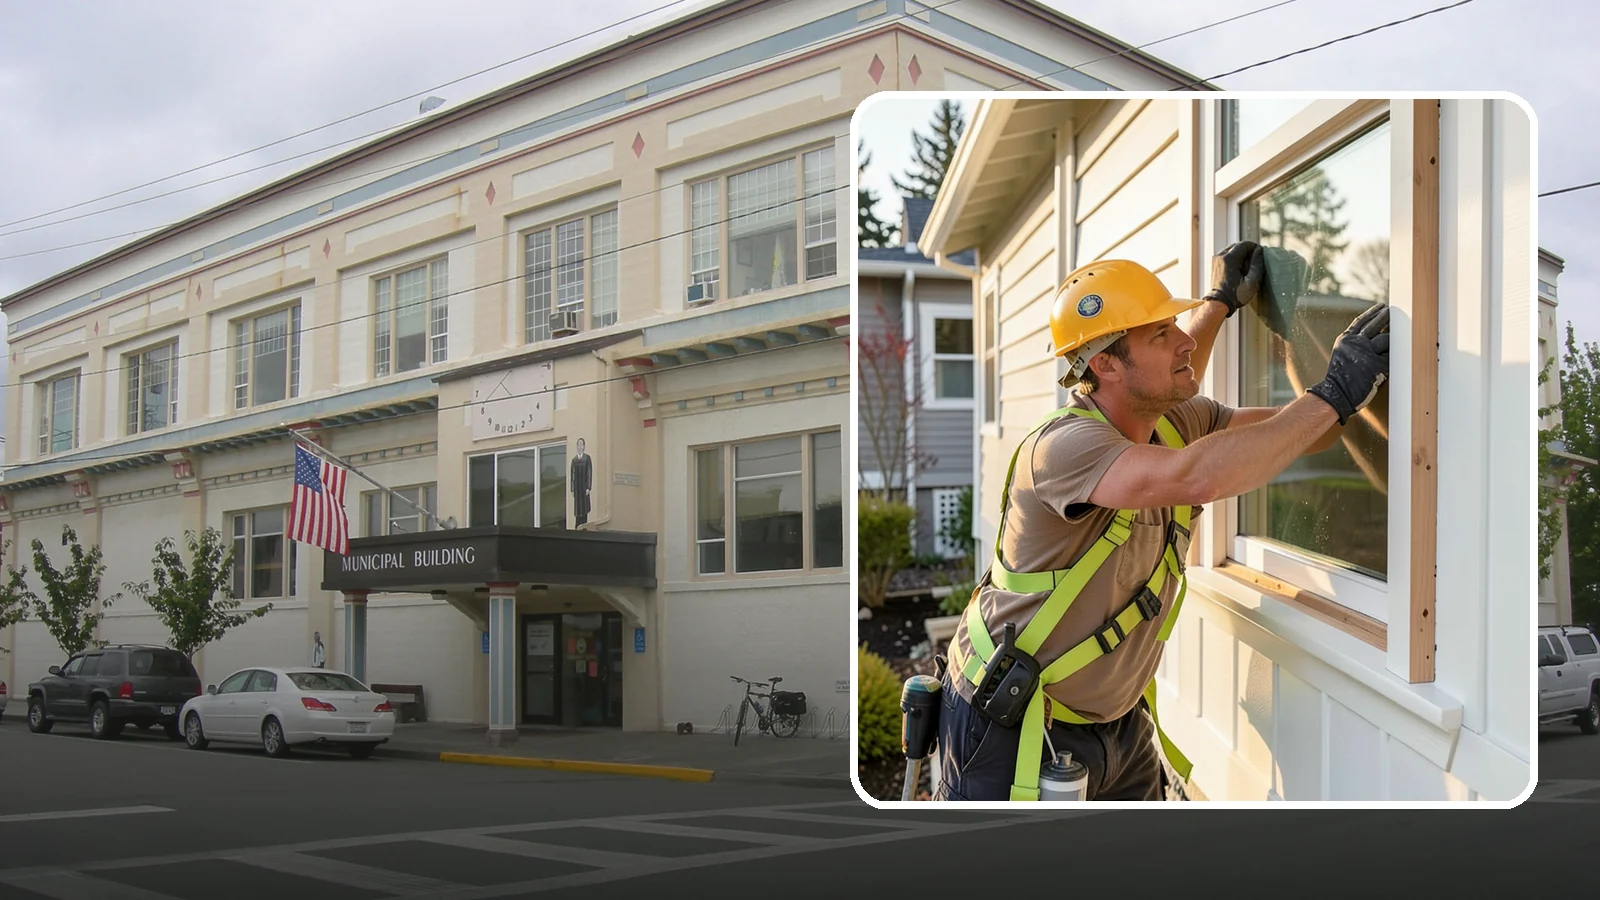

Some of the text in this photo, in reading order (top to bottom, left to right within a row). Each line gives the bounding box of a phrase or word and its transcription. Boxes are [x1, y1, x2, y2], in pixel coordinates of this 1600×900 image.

[481, 407, 485, 415] 8
[488, 417, 492, 426] 9
[494, 423, 500, 432] 10
[501, 425, 506, 433] 11
[507, 425, 513, 433] 12
[521, 420, 525, 428] 2
[529, 414, 533, 422] 3
[536, 402, 540, 410] 4
[341, 546, 475, 572] MUNICIPAL BUILDING
